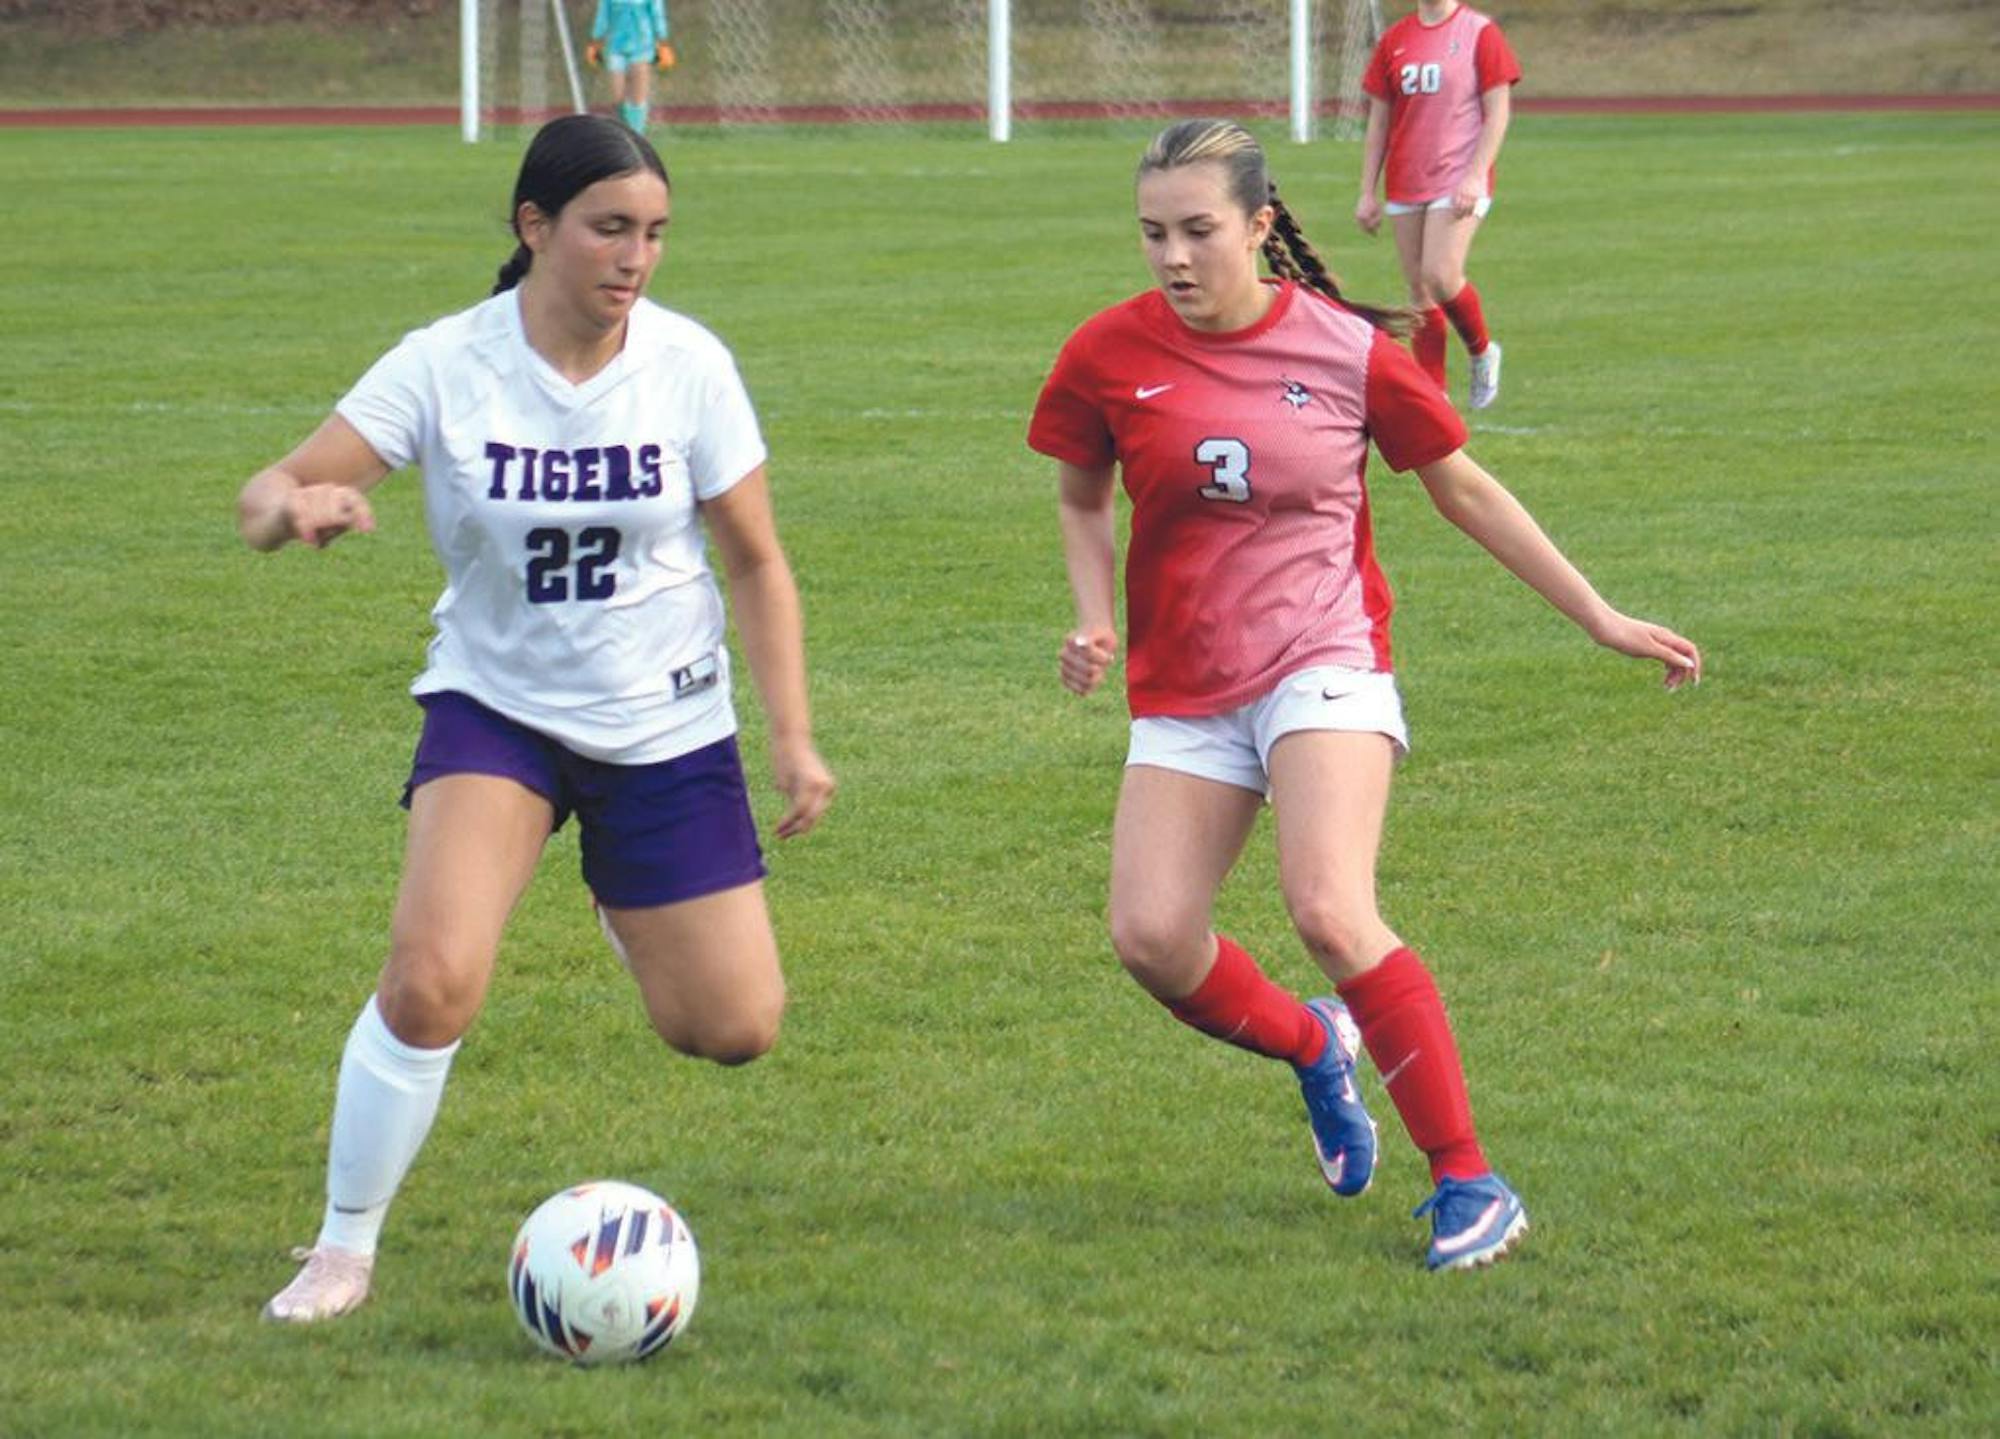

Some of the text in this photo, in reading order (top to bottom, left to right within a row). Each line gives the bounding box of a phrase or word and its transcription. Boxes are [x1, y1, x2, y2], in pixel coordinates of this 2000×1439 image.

[1401, 63, 1441, 95] 20
[485, 442, 663, 501] TIGERS
[1195, 436, 1251, 502] 3
[526, 526, 622, 604] 22
